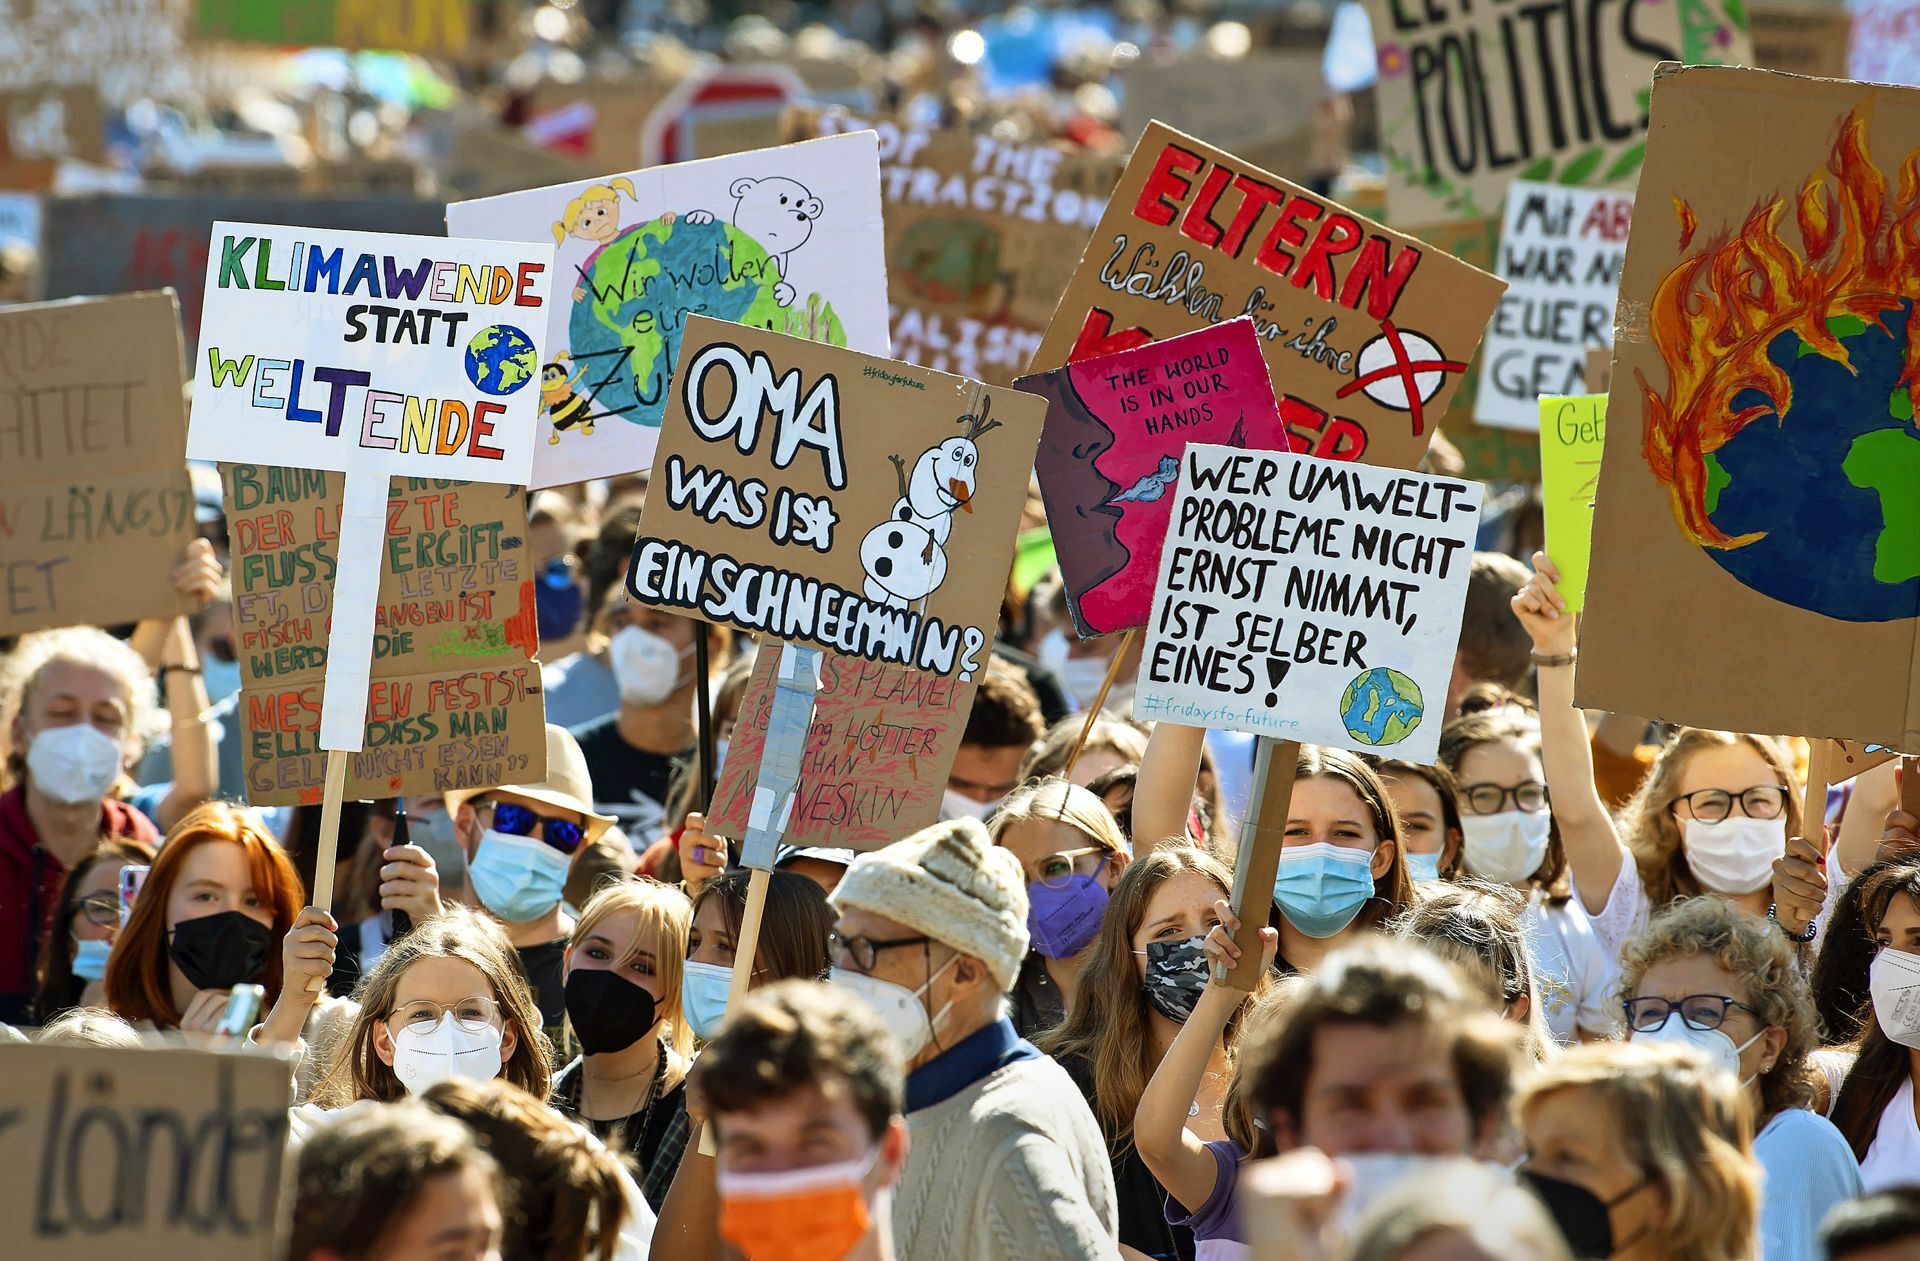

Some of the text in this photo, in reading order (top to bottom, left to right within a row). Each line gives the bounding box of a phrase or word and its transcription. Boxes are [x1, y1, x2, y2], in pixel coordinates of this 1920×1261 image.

[971, 135, 1063, 183] THE
[1132, 143, 1422, 321] ELTERN
[218, 235, 545, 307] KLIMAWENDE
[575, 237, 784, 304] Wir wollen
[1506, 246, 1576, 285] WAR
[344, 305, 468, 347] STATT
[1101, 235, 1222, 322] Wählen
[1285, 316, 1353, 375] ihre
[1105, 347, 1231, 391] THE WORLD
[1120, 374, 1231, 414] IS IN OUR
[208, 348, 507, 460] WELTENDE
[682, 342, 847, 491] OMA
[1145, 402, 1214, 436] HANDS
[233, 466, 327, 511] BAUM
[665, 455, 768, 527] WAS
[1190, 452, 1477, 523] WER UMWELT-
[235, 510, 296, 555] DER
[1178, 496, 1466, 579] PROBLEME NICHT
[0, 555, 71, 616] ET
[400, 558, 519, 599] LETZTE
[1167, 548, 1420, 636] ERNST NIMMT,
[1159, 594, 1367, 669] IST SELBER
[1149, 641, 1291, 708] EINES!
[366, 713, 439, 748] DASS
[450, 707, 508, 738] MAN
[843, 716, 937, 755] HOTTER
[1144, 693, 1300, 731] #fridaysforfuture
[438, 735, 509, 768] ESSEN
